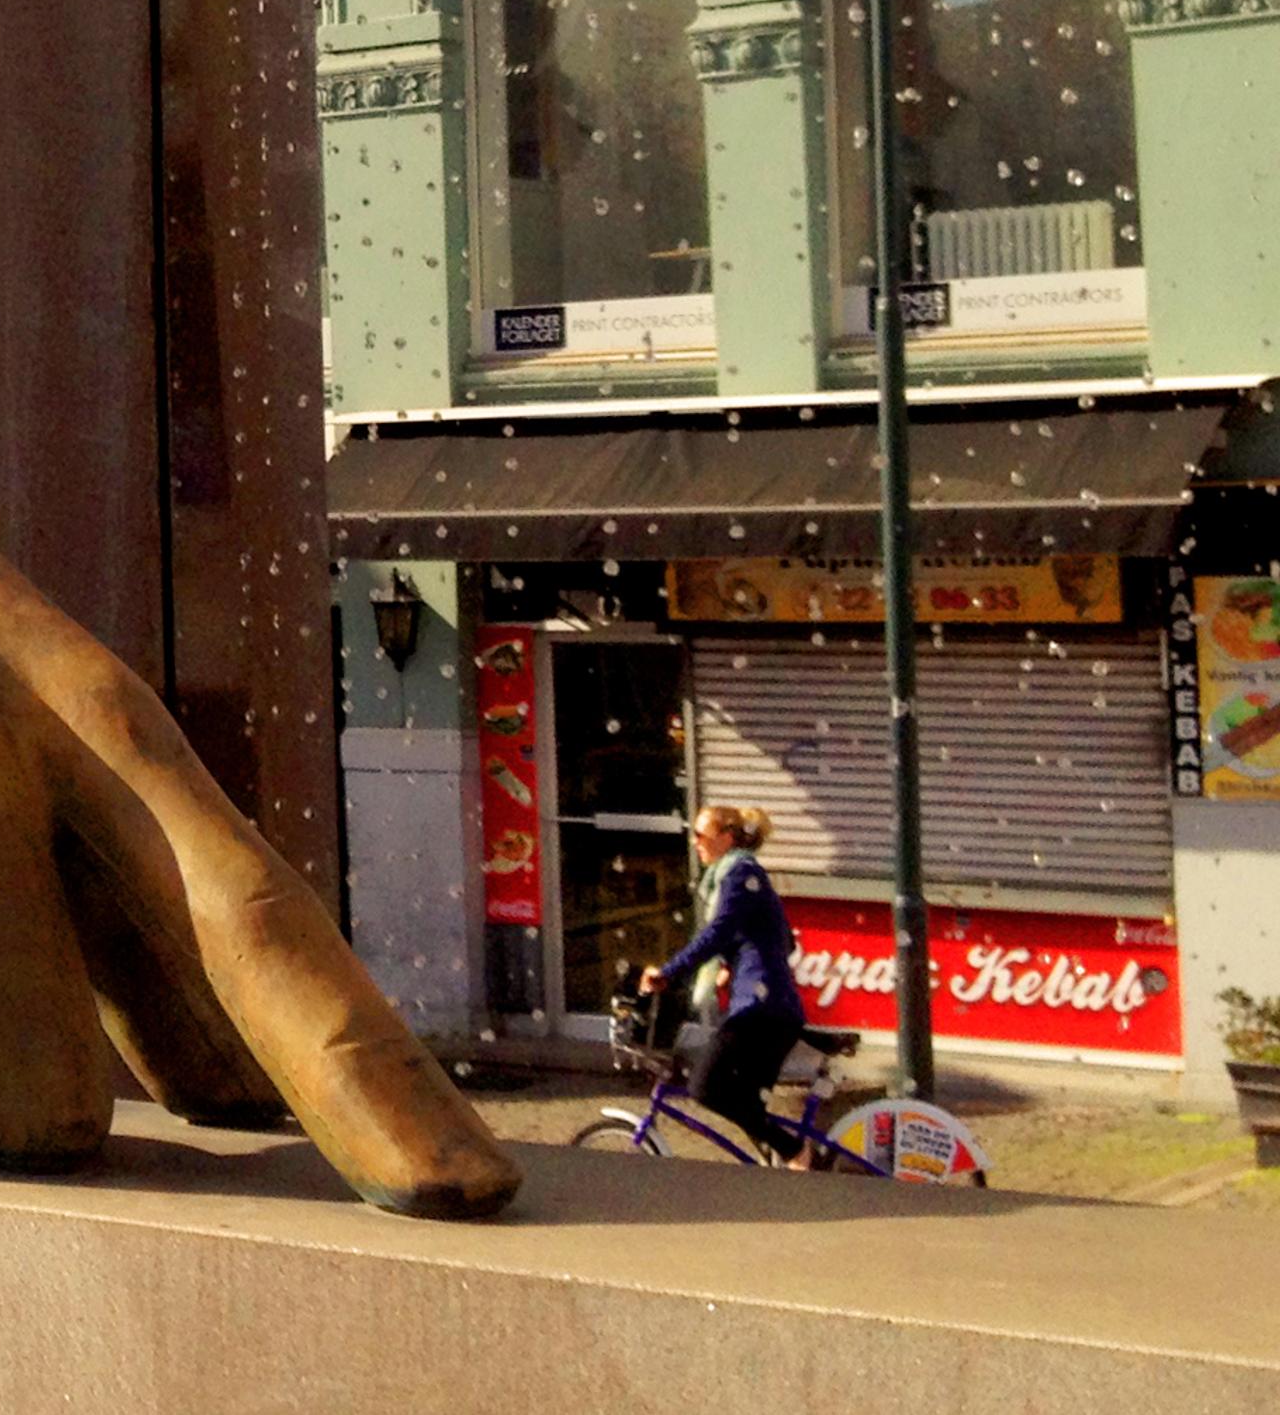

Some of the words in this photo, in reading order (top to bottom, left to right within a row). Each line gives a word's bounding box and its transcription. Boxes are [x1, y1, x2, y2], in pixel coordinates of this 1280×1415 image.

[958, 295, 1000, 309] PRINT
[501, 314, 561, 328] KALENDER
[573, 318, 610, 332] PRINT
[501, 328, 561, 344] FORLAGET
[1172, 664, 1201, 793] KEBAB
[950, 944, 1145, 1014] Kebab
